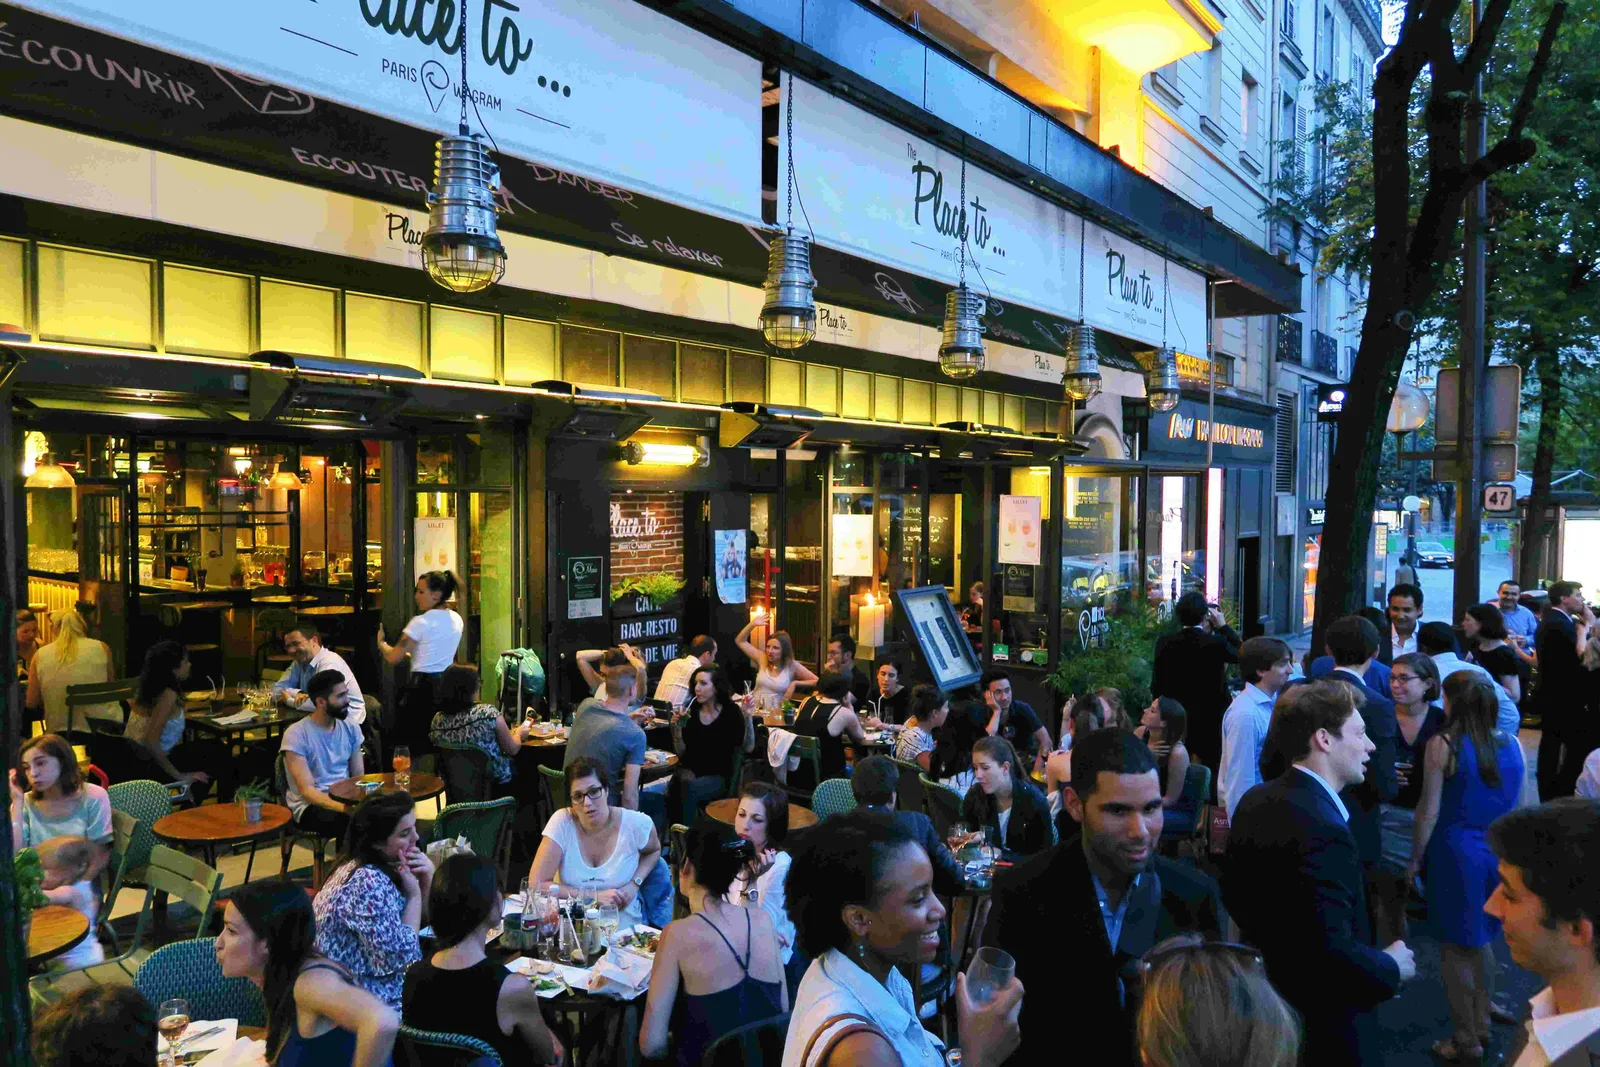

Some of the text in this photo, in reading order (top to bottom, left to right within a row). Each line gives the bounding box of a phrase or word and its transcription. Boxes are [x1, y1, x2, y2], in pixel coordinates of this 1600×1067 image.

[381, 58, 502, 112] PARIS WAGRAM
[906, 142, 917, 161] The
[290, 146, 429, 194] ECOUTER
[911, 160, 970, 243] Place
[385, 212, 427, 246] Plac
[610, 221, 725, 269] Se relaxer
[1106, 247, 1140, 306] Place
[819, 307, 840, 329] Place
[1488, 491, 1509, 506] 47
[620, 617, 677, 640] BAR-RESTO
[645, 646, 658, 664] DE
[661, 643, 678, 661] VIE
